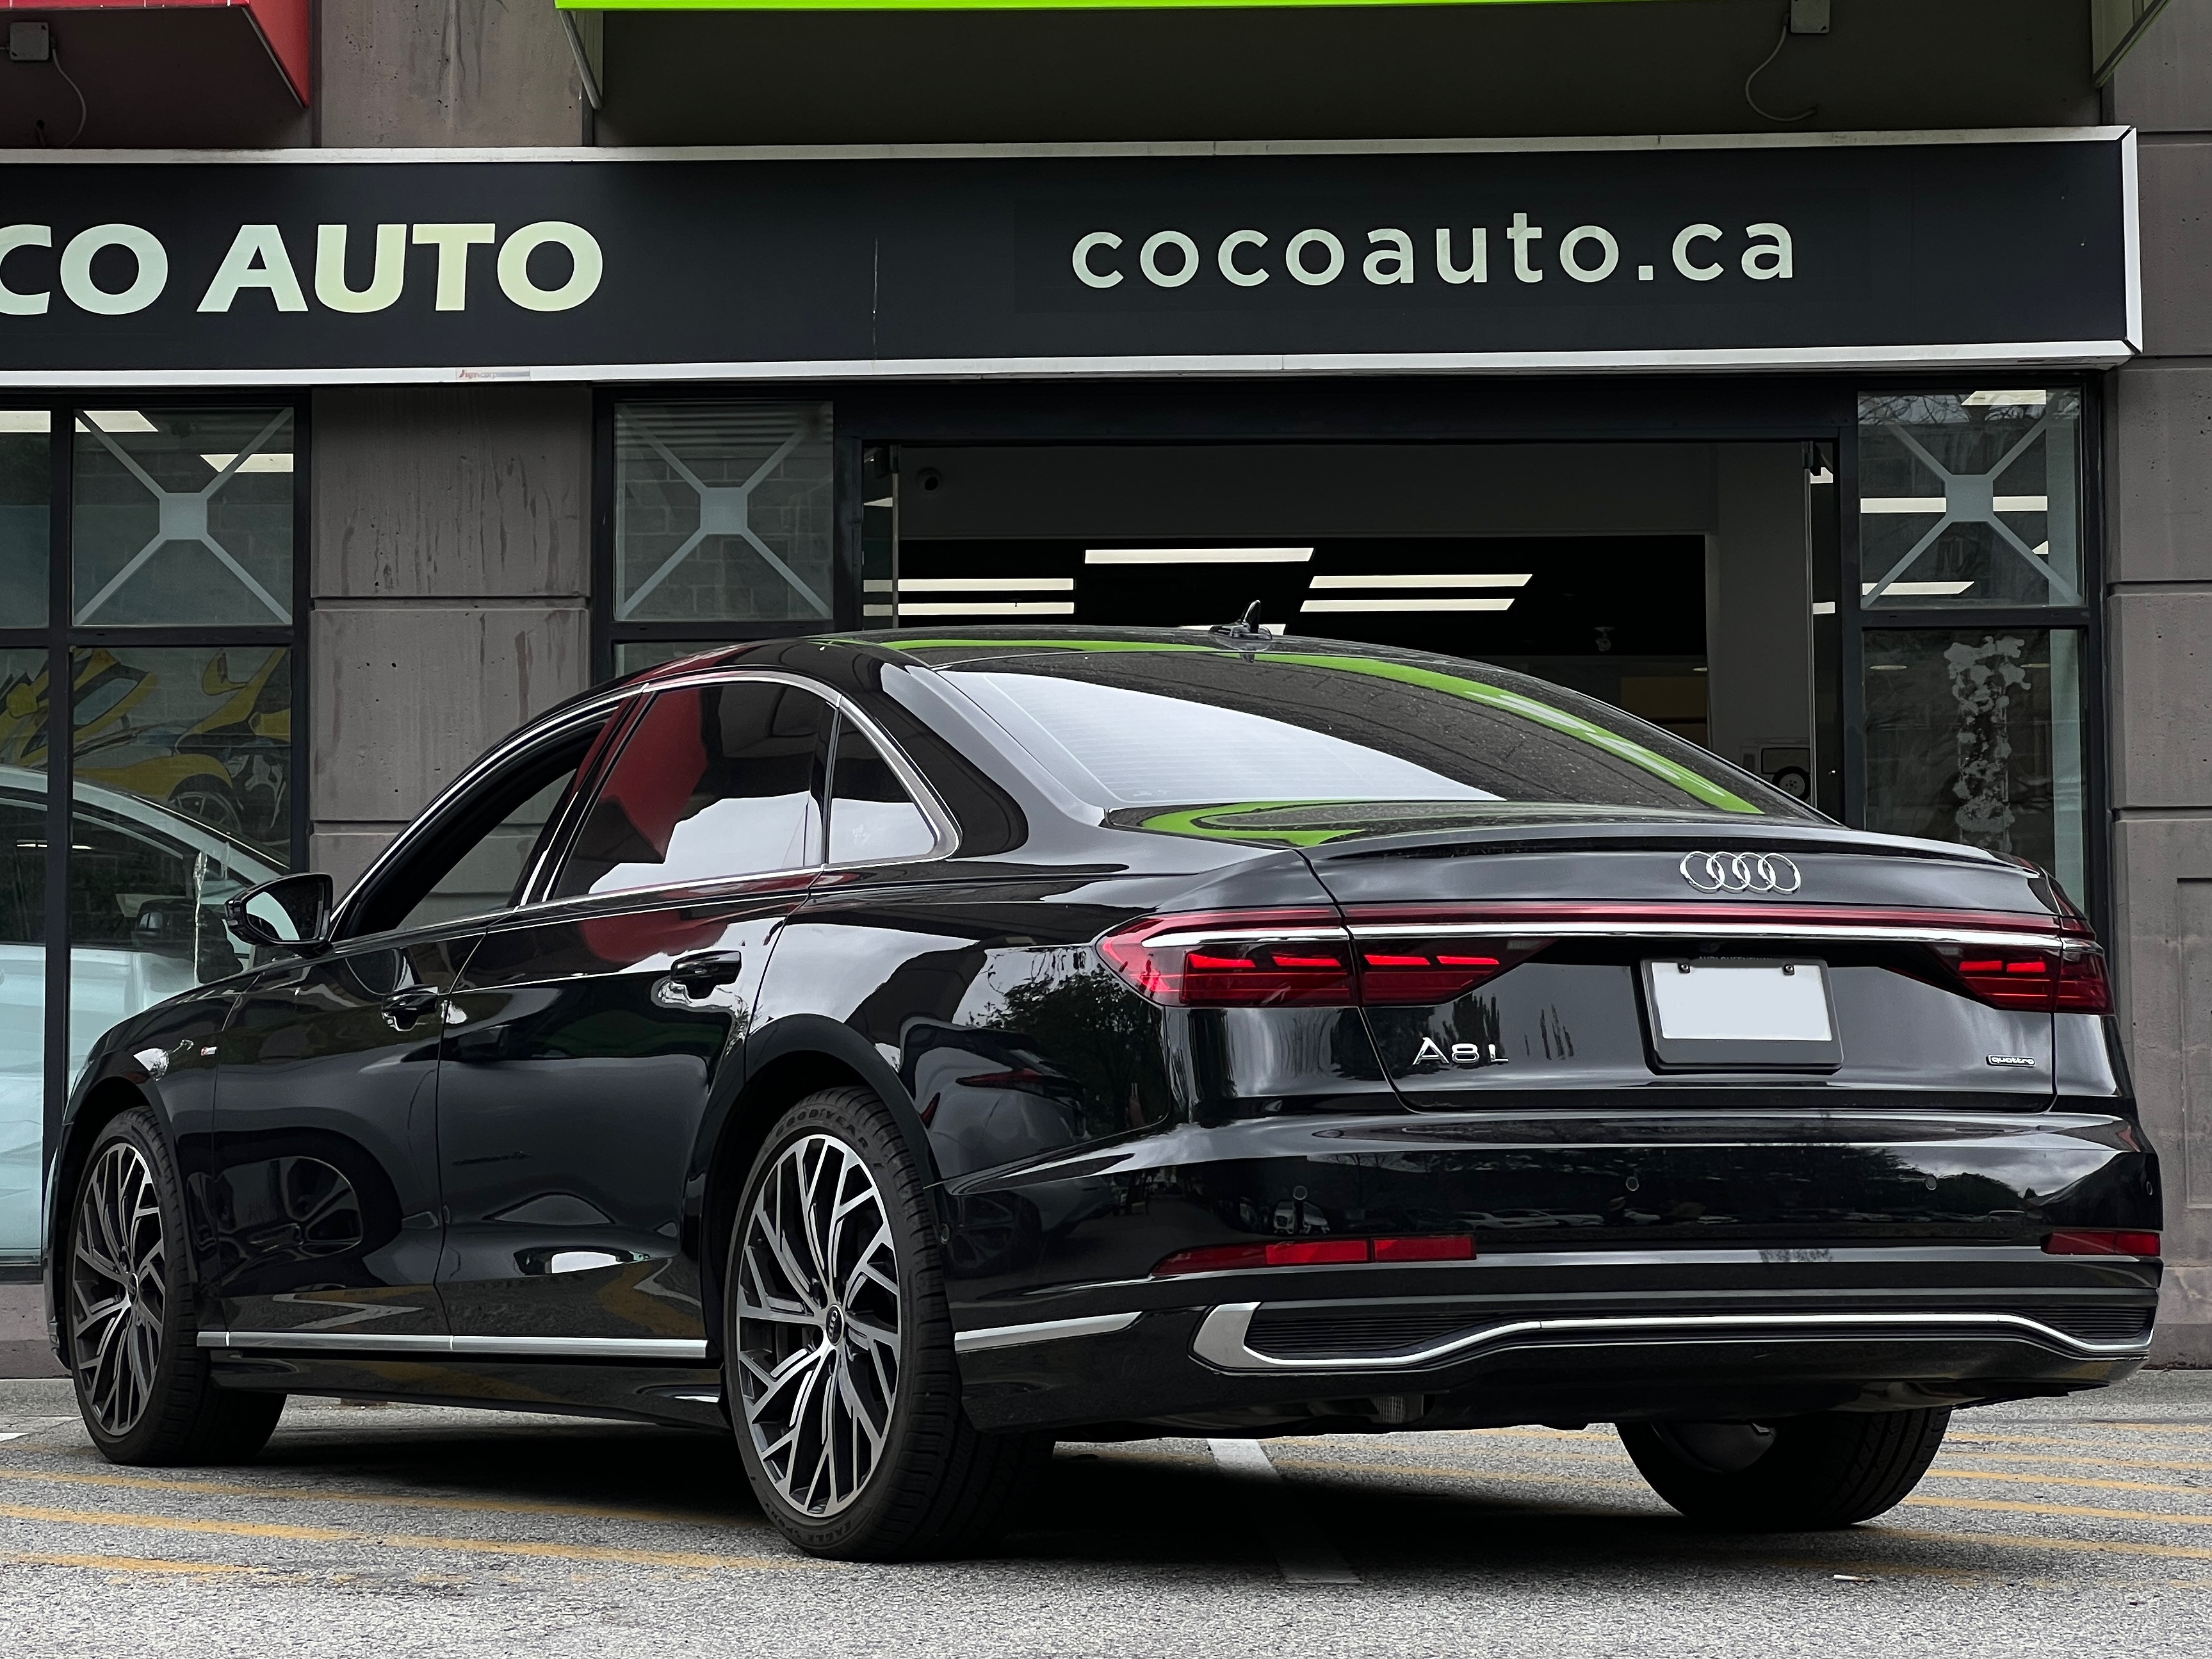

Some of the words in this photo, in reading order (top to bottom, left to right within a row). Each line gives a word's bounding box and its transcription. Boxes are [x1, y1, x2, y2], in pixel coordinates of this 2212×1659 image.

[0, 224, 168, 316] CO
[196, 221, 603, 313] AUTO
[1072, 213, 1793, 288] cocoauto.ca
[776, 1108, 868, 1150] GOODYEAR
